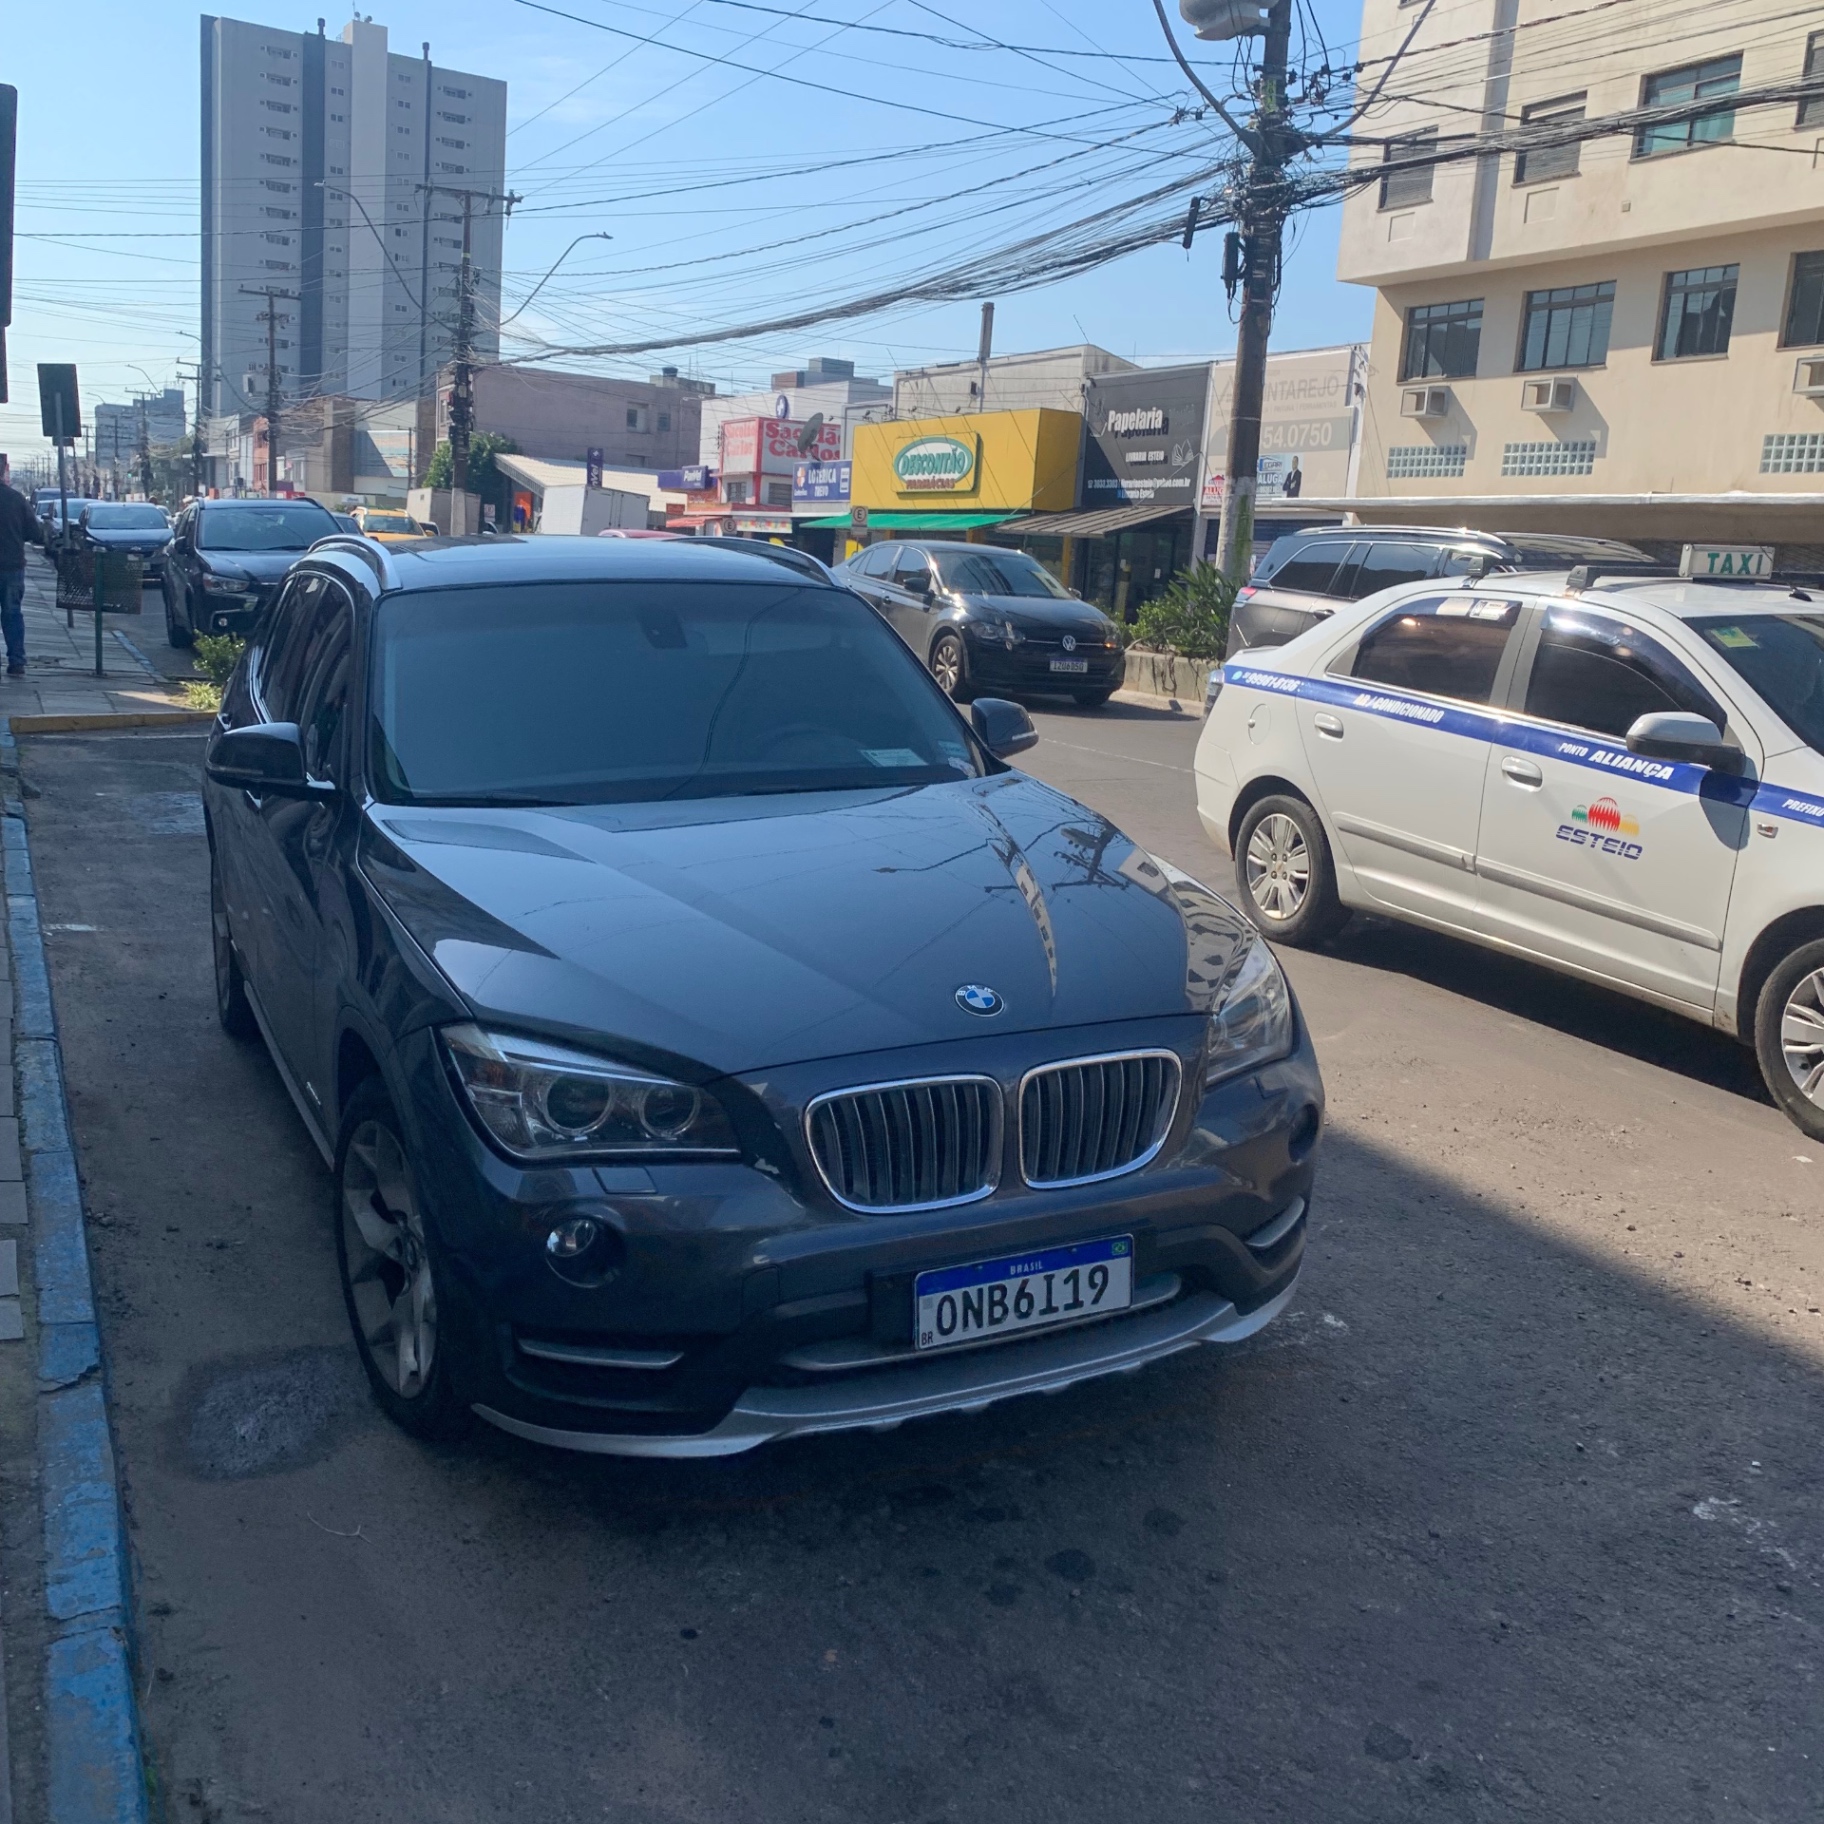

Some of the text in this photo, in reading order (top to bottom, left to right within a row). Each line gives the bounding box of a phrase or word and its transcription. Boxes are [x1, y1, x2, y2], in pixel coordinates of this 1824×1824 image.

[1108, 407, 1163, 433] Papelaria
[1262, 422, 1332, 449] 54.0750
[900, 445, 966, 476] DESCONTÃO
[1126, 451, 1147, 463] LIVRARIA
[1708, 552, 1763, 575] TAXI
[1558, 742, 1675, 780] PONTO ALIANÇA
[1781, 798, 1824, 818] PREFIXO
[1555, 824, 1643, 861] ESTEIO
[1010, 1260, 1043, 1275] BRASIL
[936, 1264, 1109, 1337] ONB6I19
[921, 1330, 933, 1346] BR
